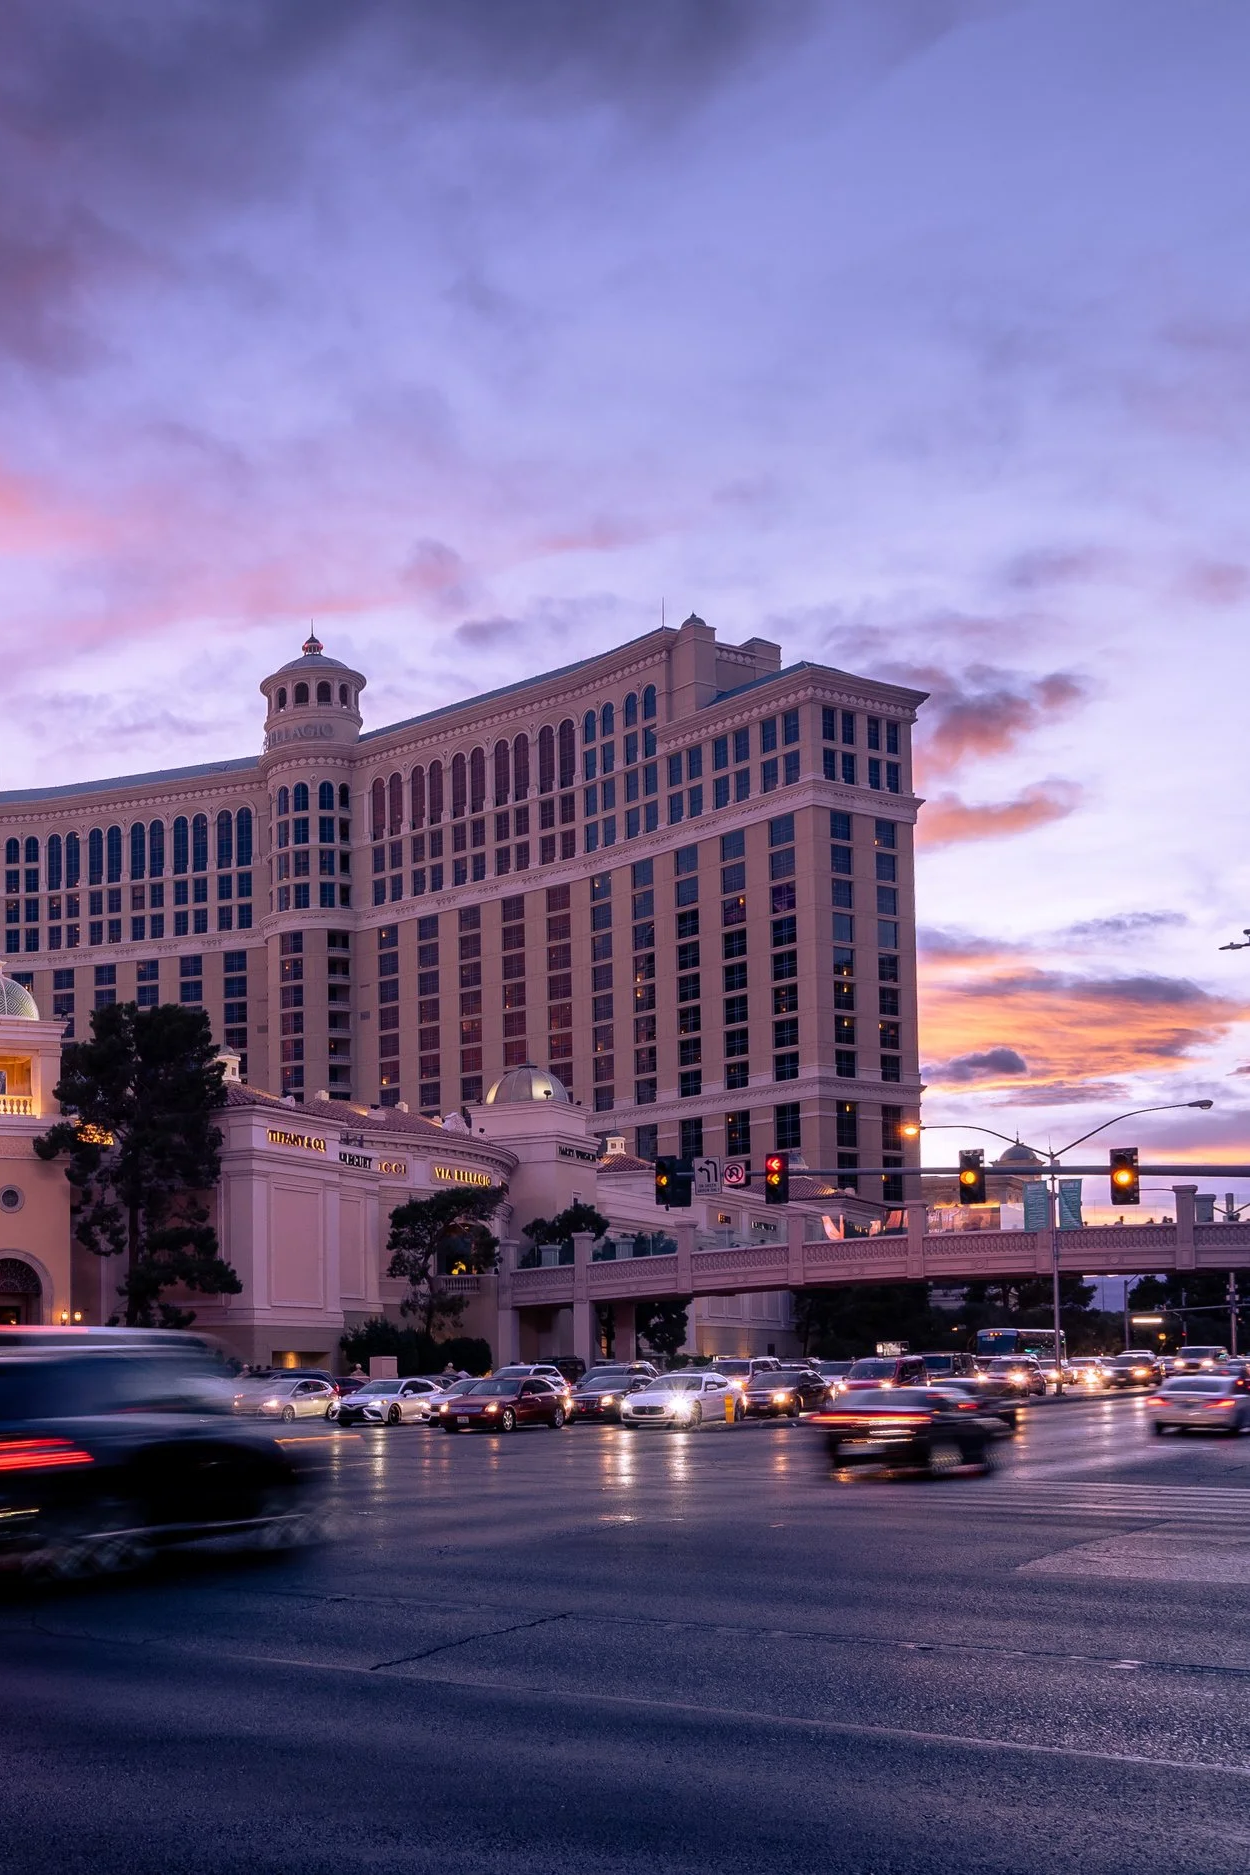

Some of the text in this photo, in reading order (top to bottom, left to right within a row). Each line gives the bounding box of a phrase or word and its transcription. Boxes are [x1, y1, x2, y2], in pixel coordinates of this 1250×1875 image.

[267, 1129, 303, 1148] TIFFANY
[303, 1135, 312, 1149] &
[434, 1167, 453, 1180] VIA
[454, 1169, 492, 1187] BELLAGIO
